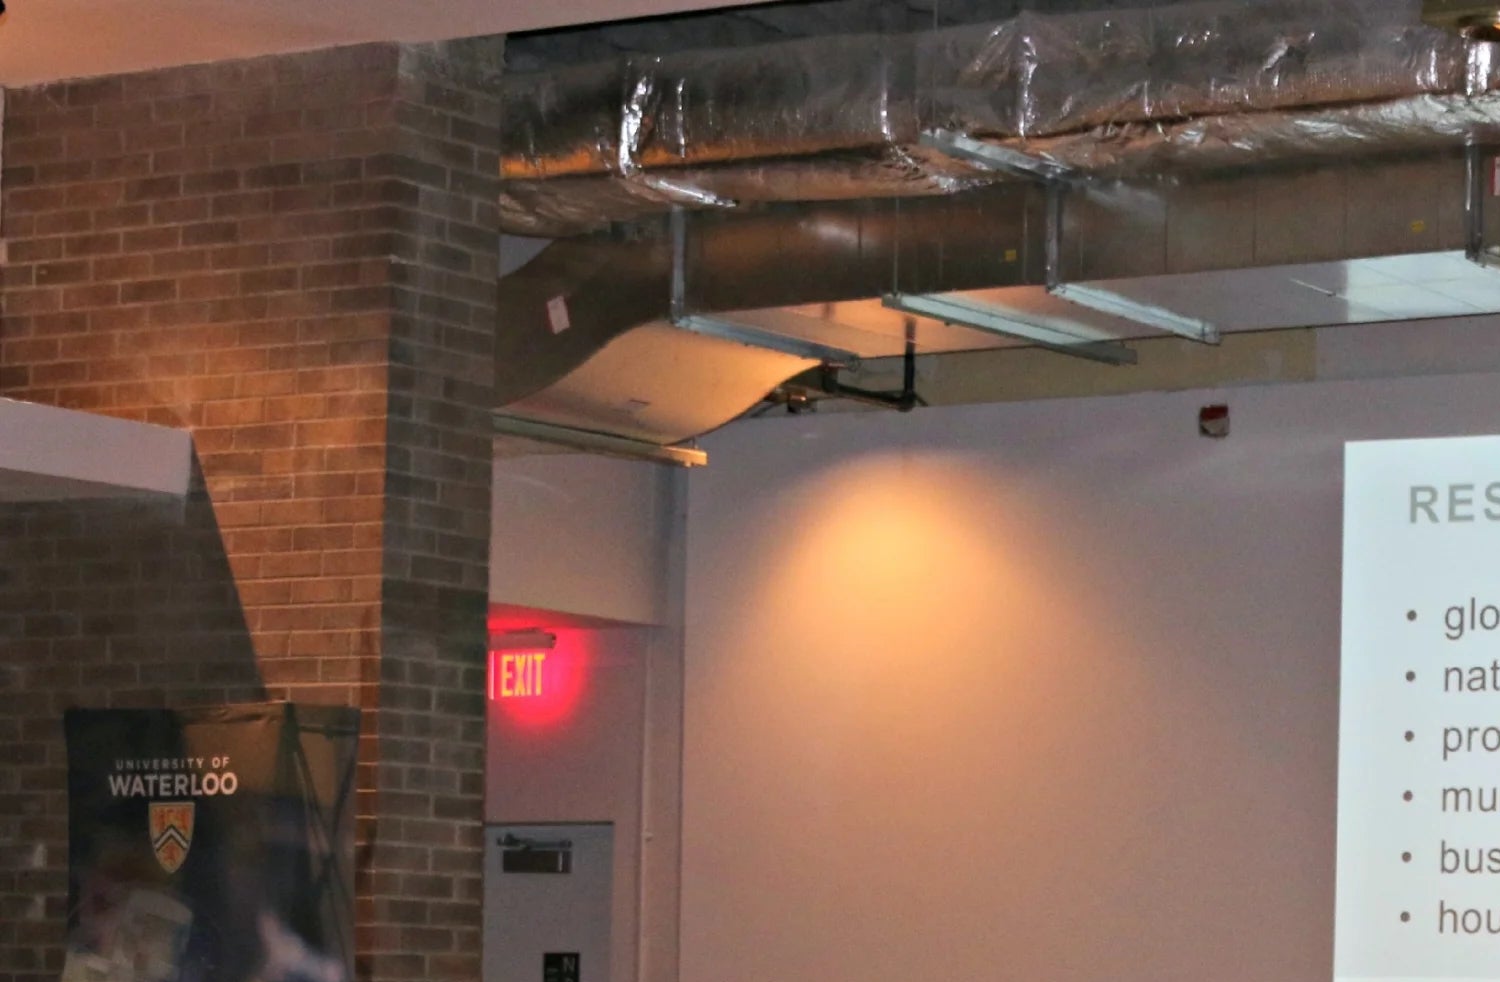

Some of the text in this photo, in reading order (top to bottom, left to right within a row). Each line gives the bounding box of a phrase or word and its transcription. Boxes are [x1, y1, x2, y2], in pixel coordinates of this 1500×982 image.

[502, 654, 545, 697] EXIT
[116, 757, 230, 770] UNIVERSITY OF
[108, 772, 238, 796] WATERLOO
